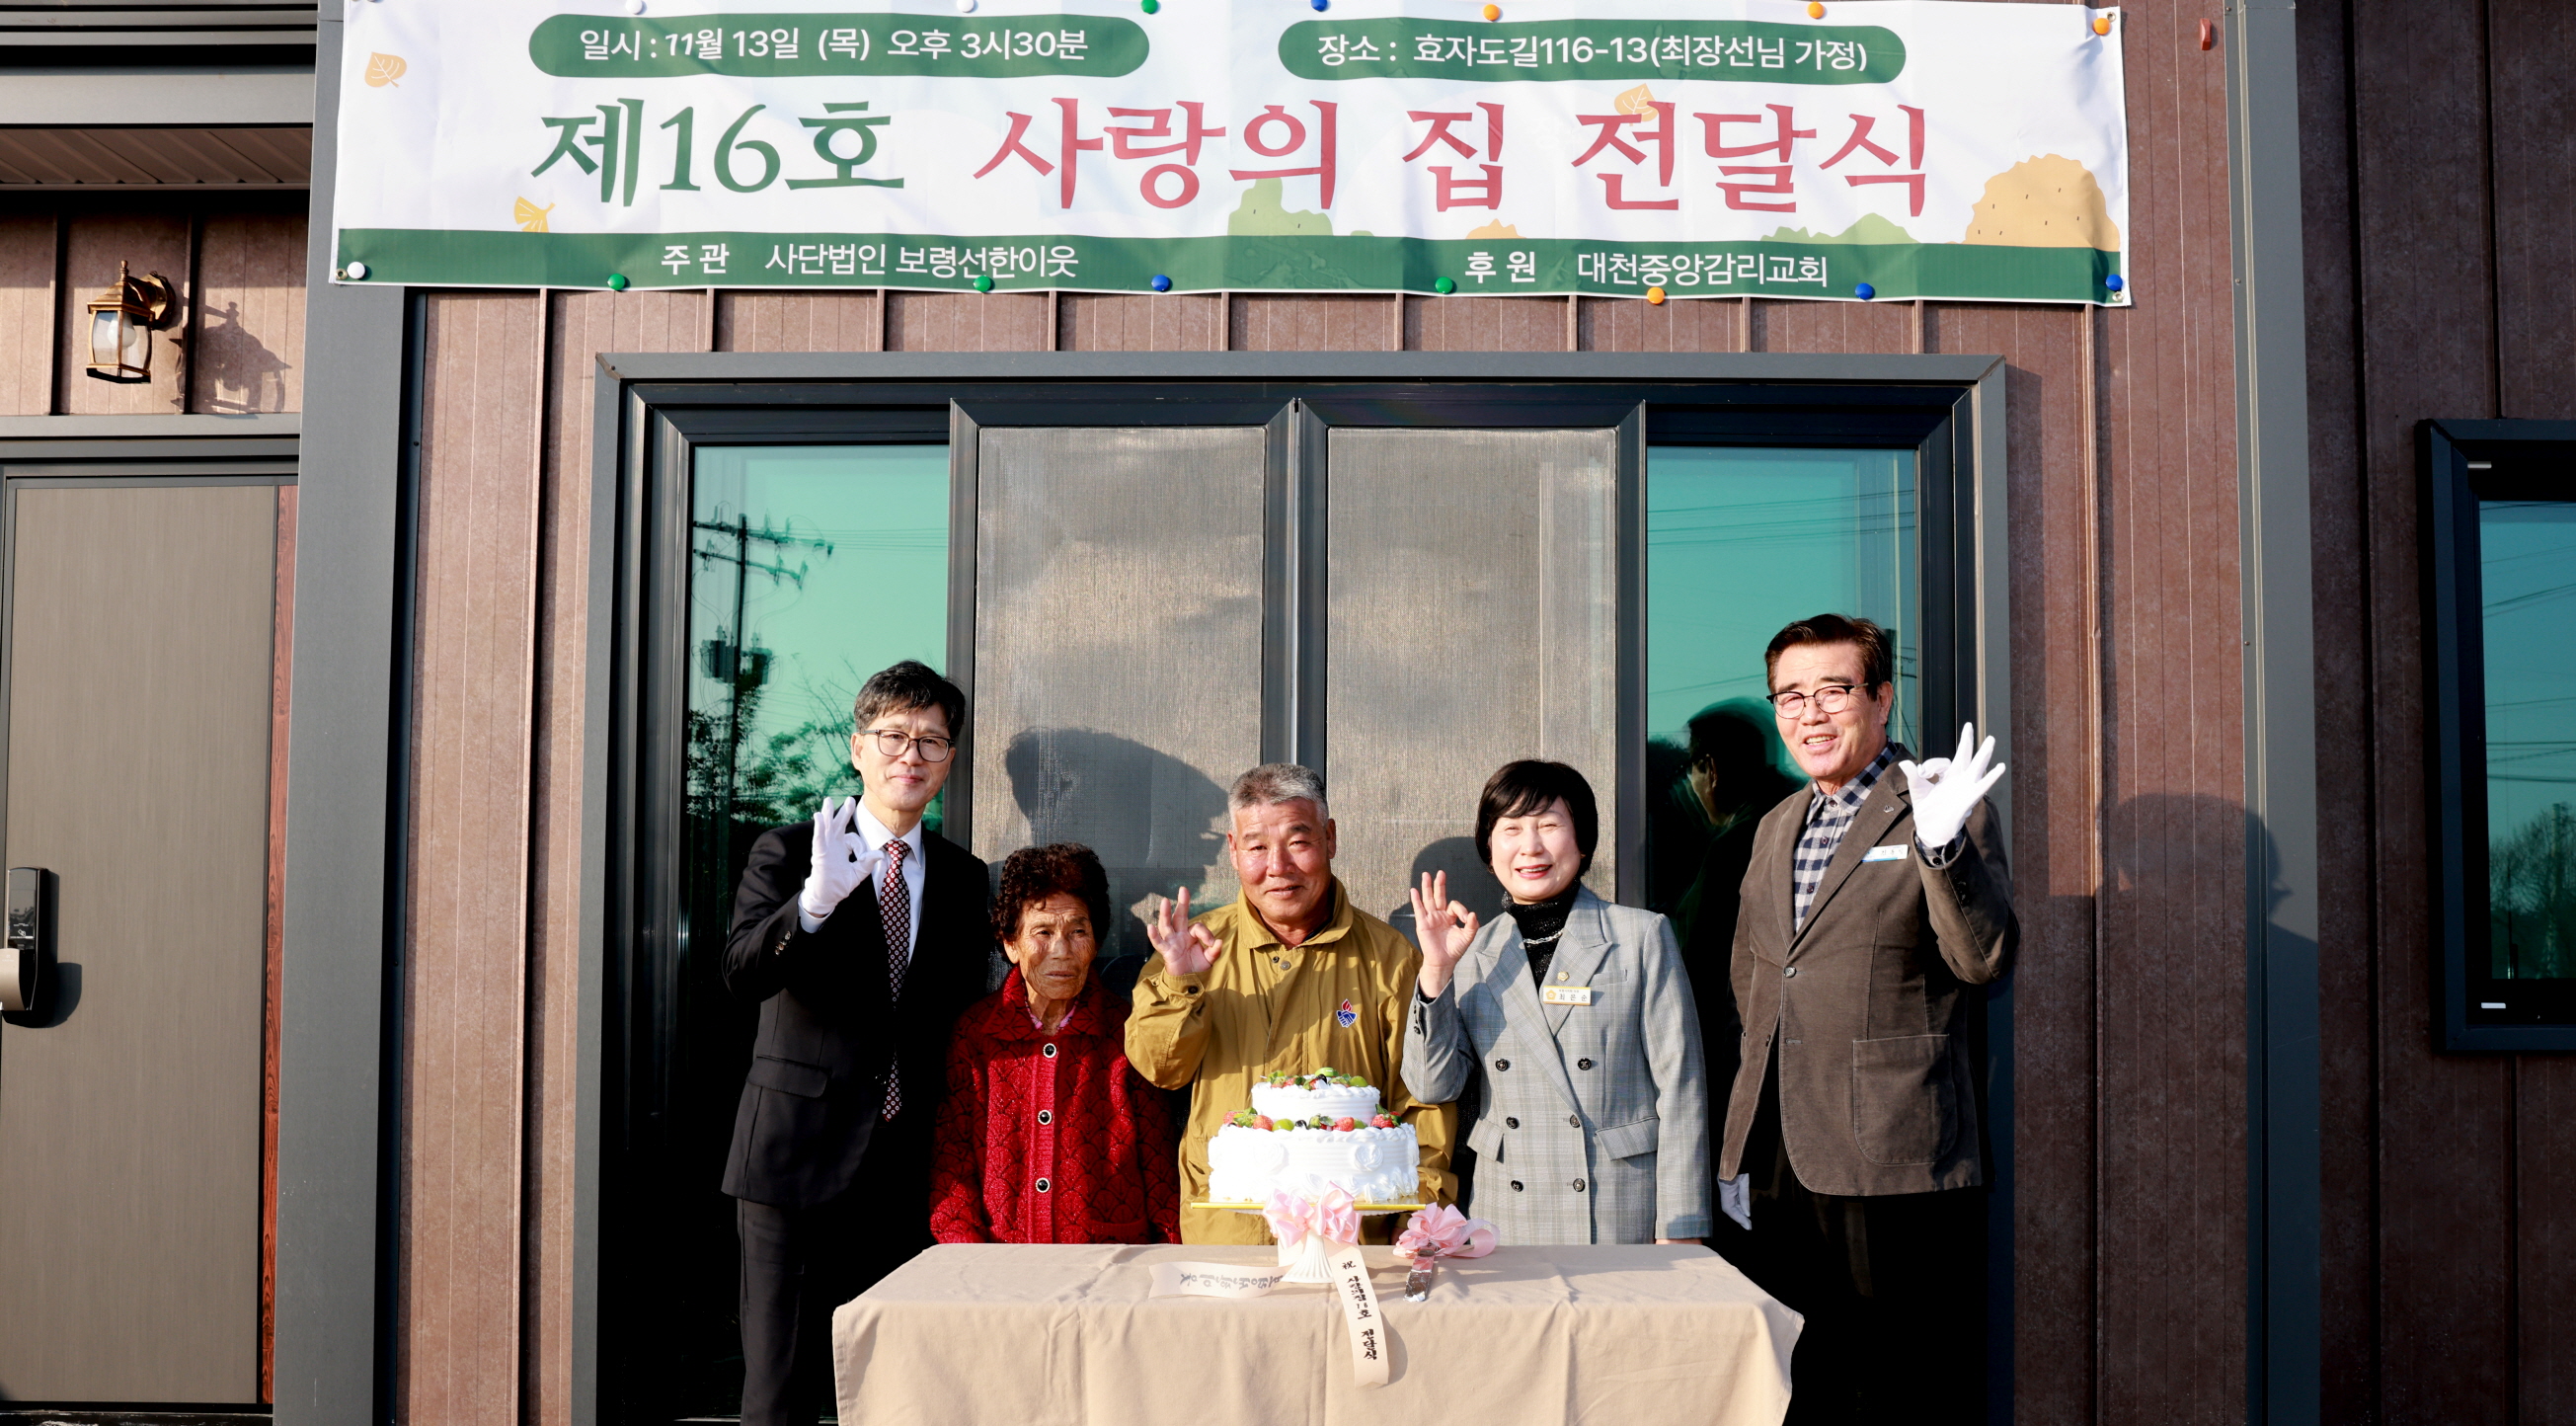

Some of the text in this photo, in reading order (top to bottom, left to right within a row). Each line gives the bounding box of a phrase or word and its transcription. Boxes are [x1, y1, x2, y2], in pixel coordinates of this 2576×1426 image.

[664, 28, 724, 60] 11월
[733, 27, 799, 60] 13일
[818, 28, 870, 61] (목)
[887, 29, 952, 60] 오후
[960, 29, 1088, 61] 3시30분
[1794, 39, 1867, 71] 가정)
[531, 98, 1926, 217] 제16호 사랑의 집 전달식
[764, 242, 887, 276] 사단법인
[895, 244, 1080, 279] 보령선한이웃
[1578, 252, 1828, 288] 대천중앙감리교회
